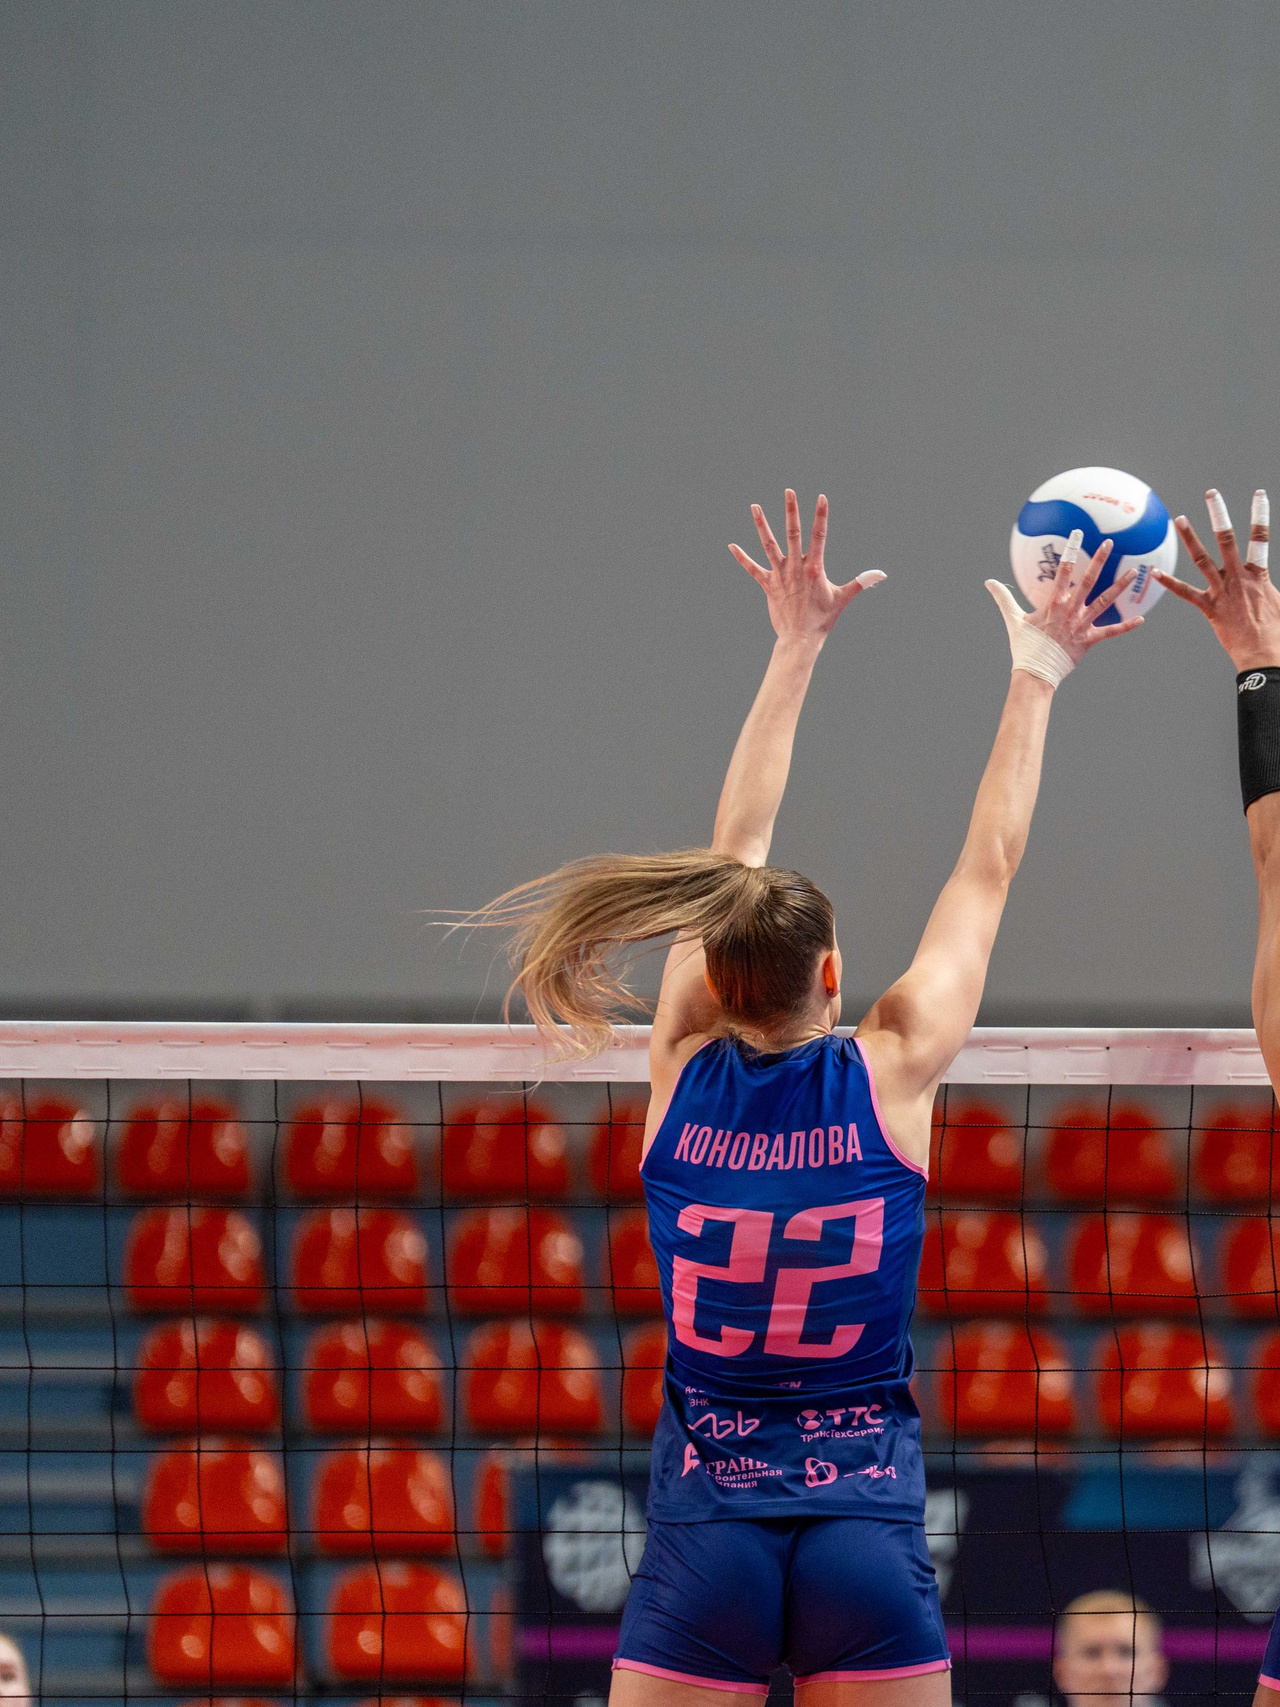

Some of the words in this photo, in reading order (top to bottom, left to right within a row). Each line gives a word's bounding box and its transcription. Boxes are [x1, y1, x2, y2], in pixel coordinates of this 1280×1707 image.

[674, 1123, 863, 1170] КОНОВАЛОВА
[672, 1197, 885, 1358] 22
[826, 1404, 884, 1426] ТТС
[711, 1469, 782, 1482] роительная
